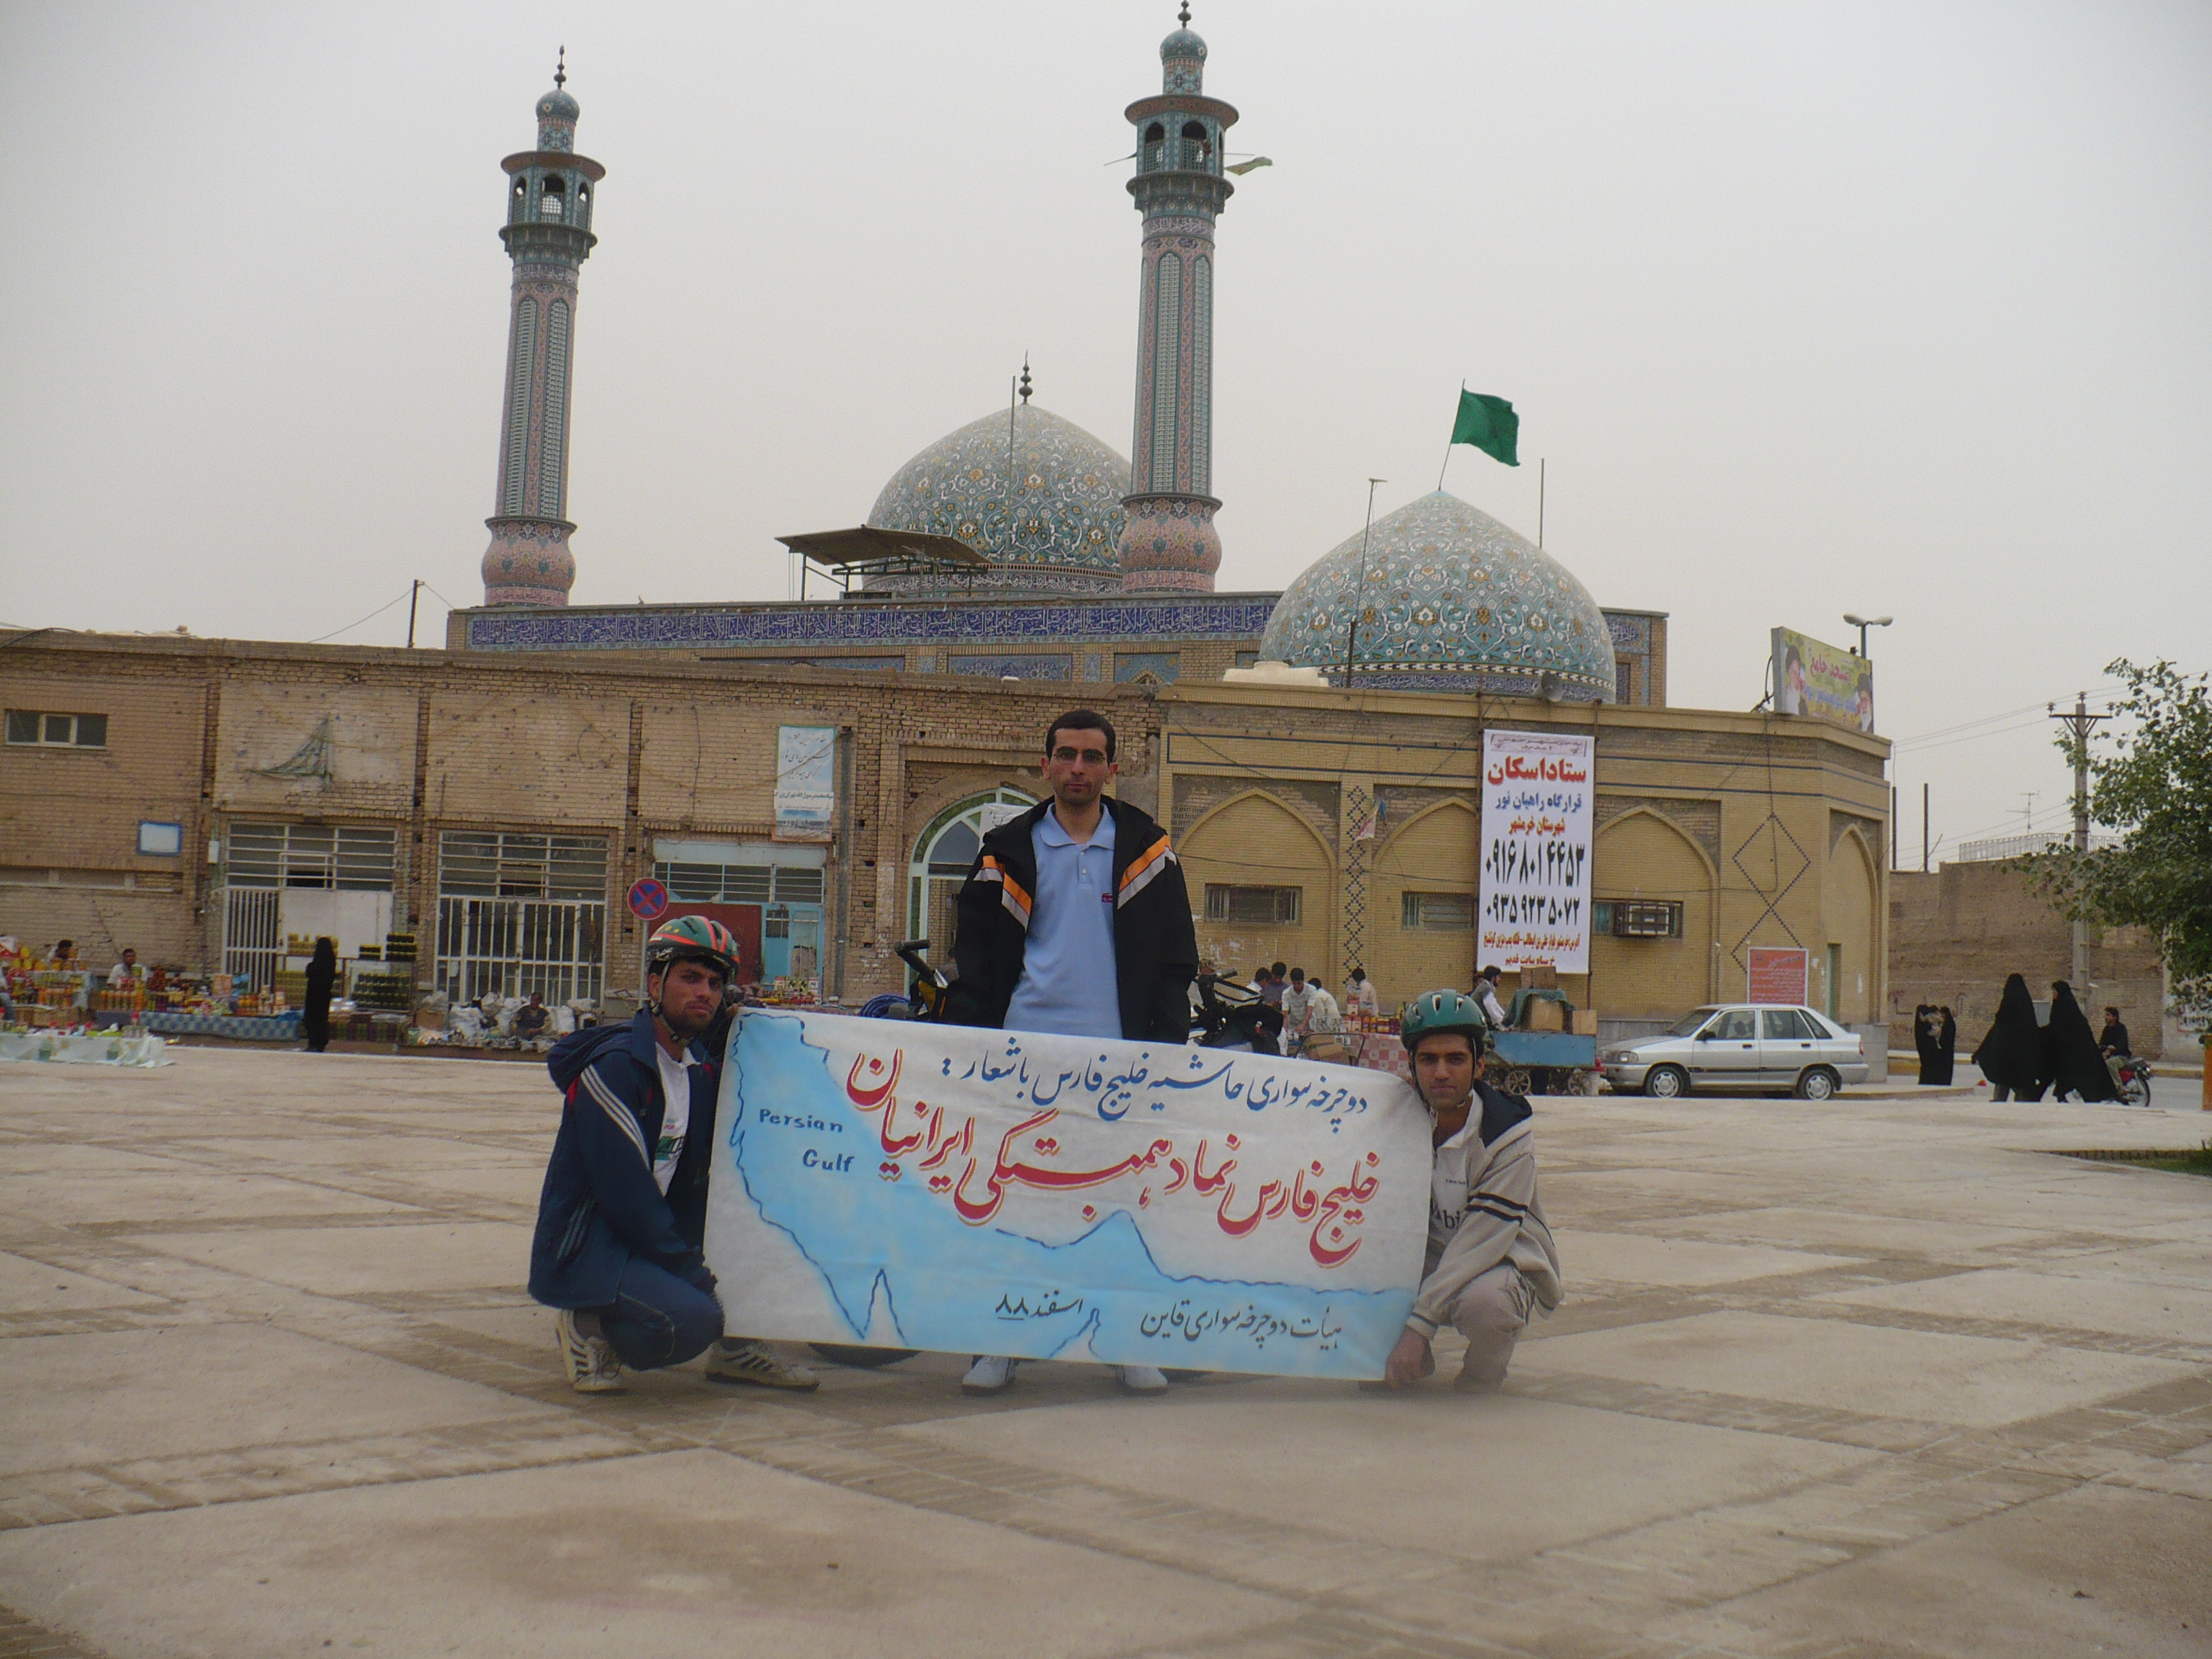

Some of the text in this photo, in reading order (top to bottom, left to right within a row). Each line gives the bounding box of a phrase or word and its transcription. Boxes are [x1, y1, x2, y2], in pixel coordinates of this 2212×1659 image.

[1496, 791, 1582, 813] قرارگاه راهیان نور
[1031, 1053, 1107, 1106] فارس
[1097, 1051, 1150, 1121] خلیج
[1146, 1053, 1245, 1112] حاشیه
[1246, 1075, 1312, 1112] سواری
[759, 1108, 843, 1133] Persian
[802, 1148, 855, 1173] Gulf
[846, 1048, 1380, 1269] خلیج فارس نماد همبستگی ایرانیان
[1029, 1290, 1084, 1318] اسفند
[1140, 1299, 1192, 1339] قاین
[1183, 1309, 1240, 1341] سواری
[1236, 1304, 1287, 1349] دوچرخه
